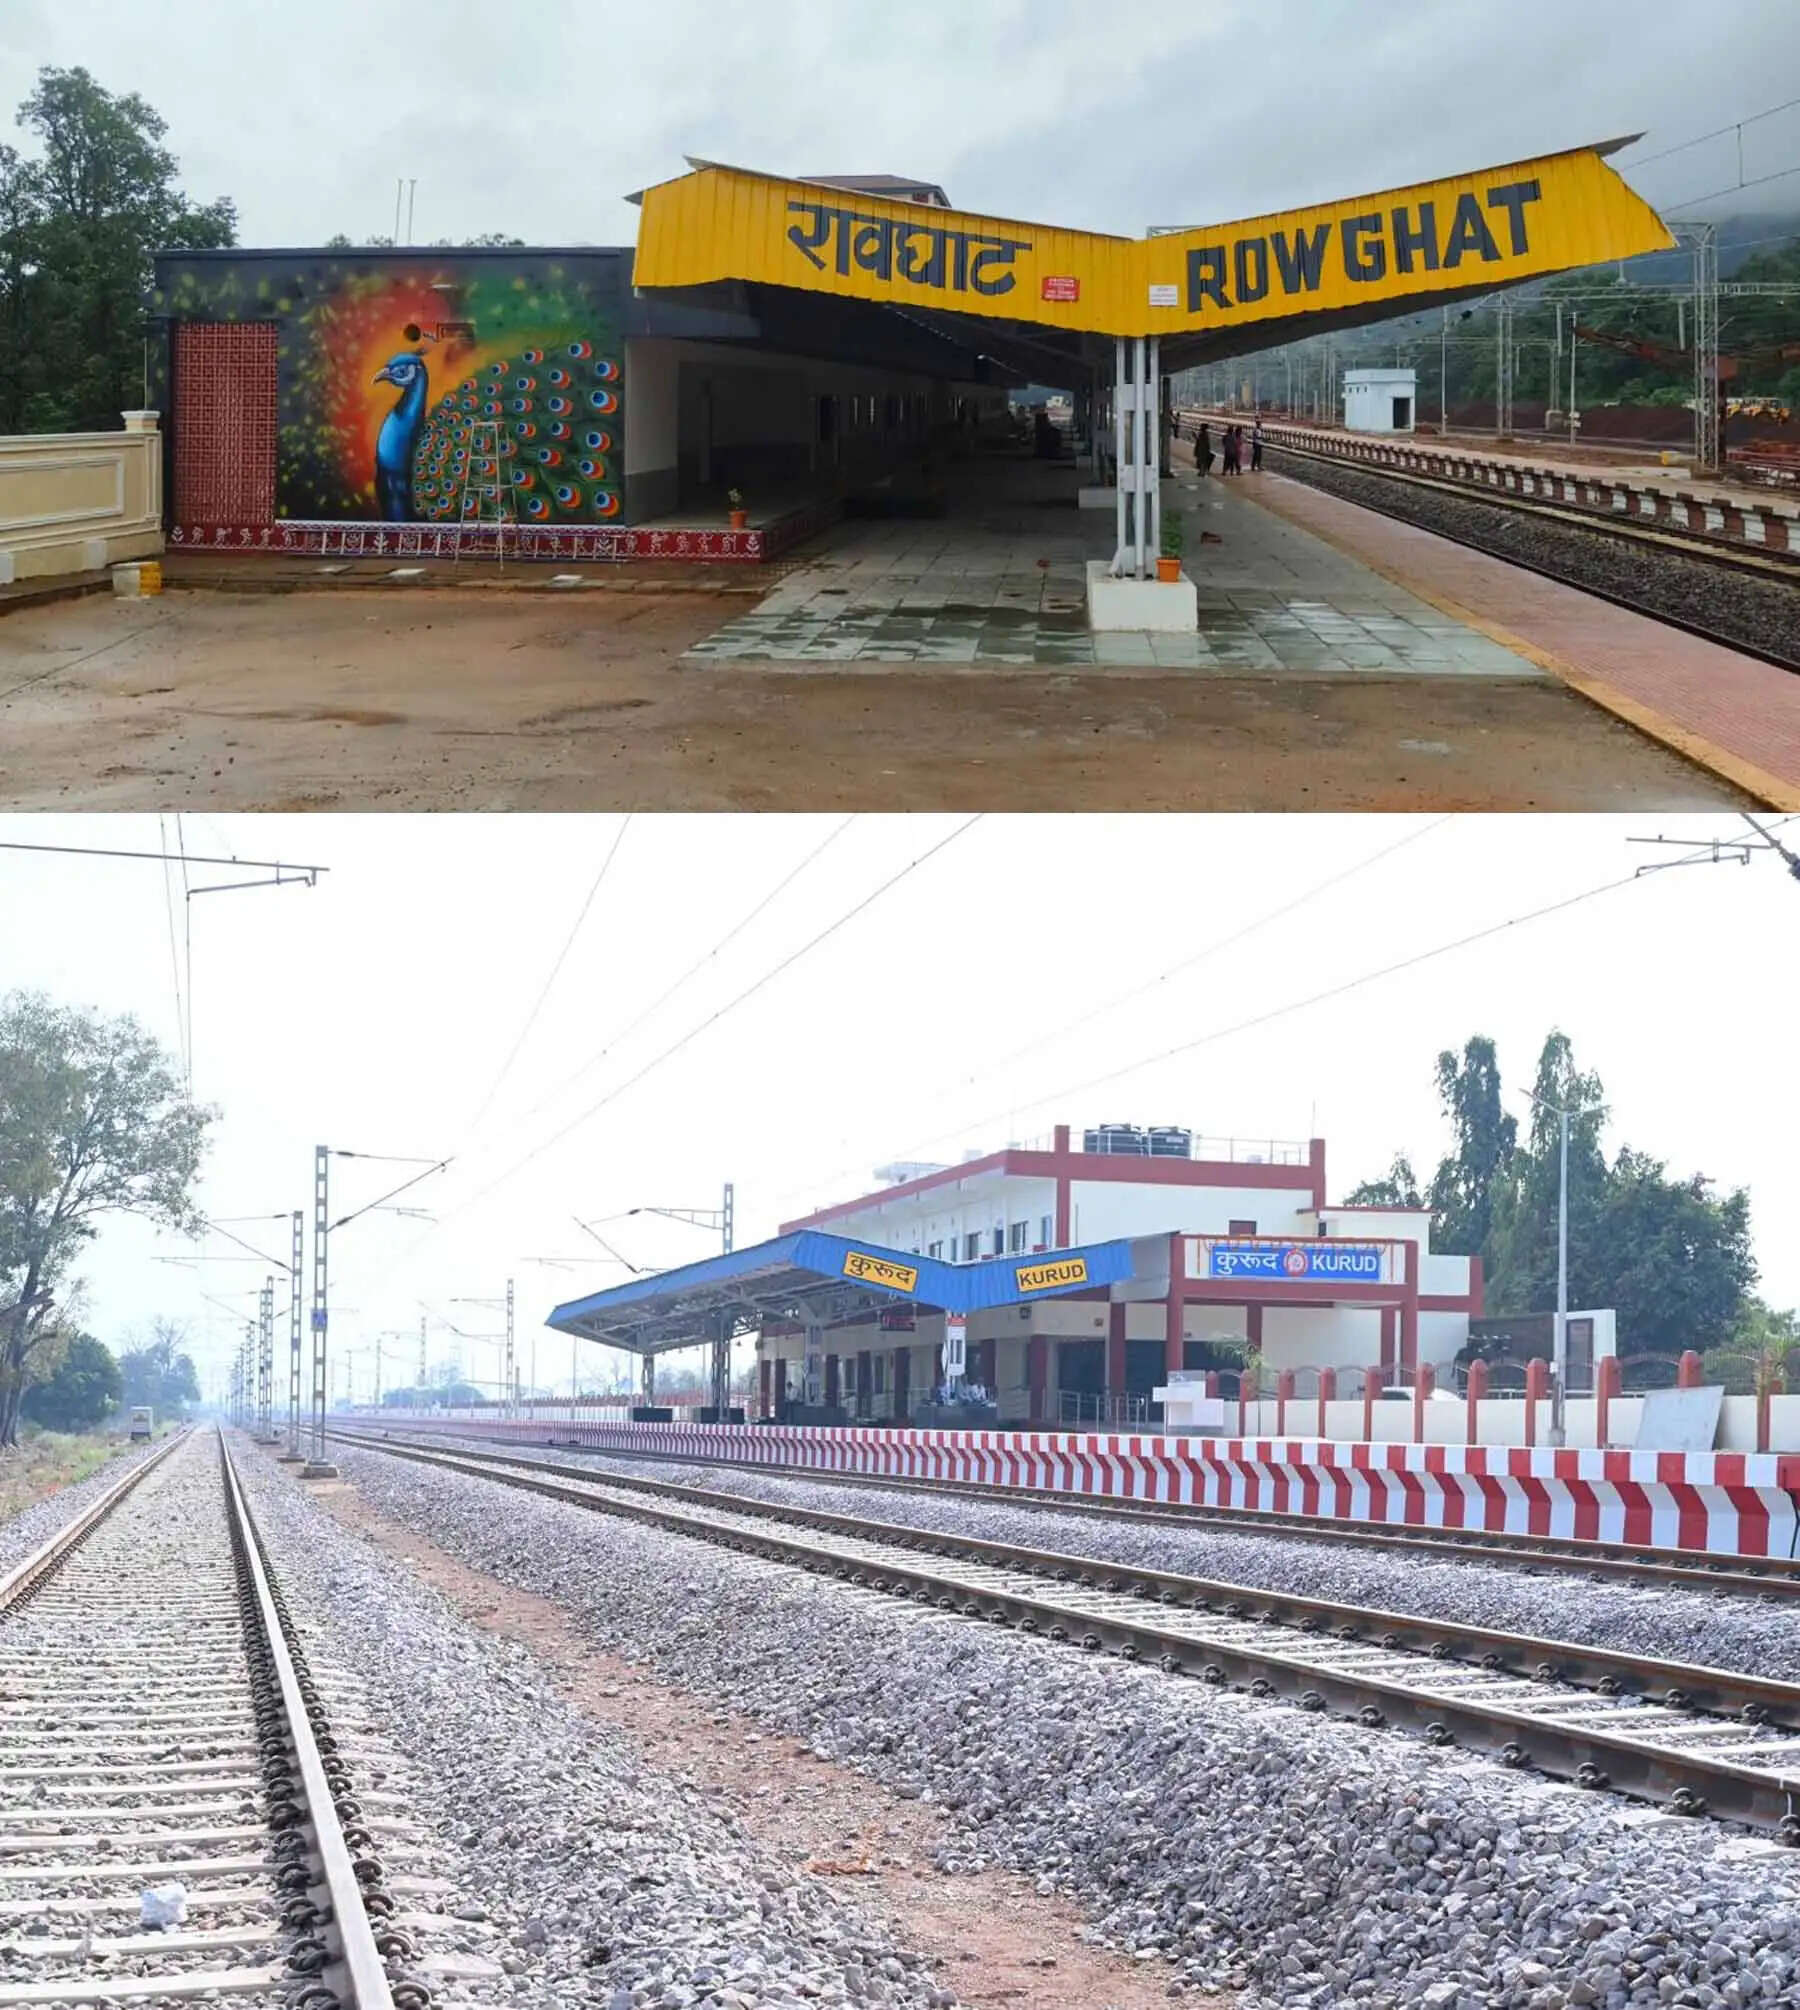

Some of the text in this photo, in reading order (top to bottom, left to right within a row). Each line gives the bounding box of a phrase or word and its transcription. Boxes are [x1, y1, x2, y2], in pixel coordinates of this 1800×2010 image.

[787, 201, 1032, 296] रावघाट
[1186, 179, 1541, 313] ROWGHAT
[850, 1254, 914, 1285] कुरूद
[1019, 1263, 1085, 1287] KURUD
[1216, 1251, 1279, 1275] कुरूद
[1312, 1253, 1377, 1272] KURUD
